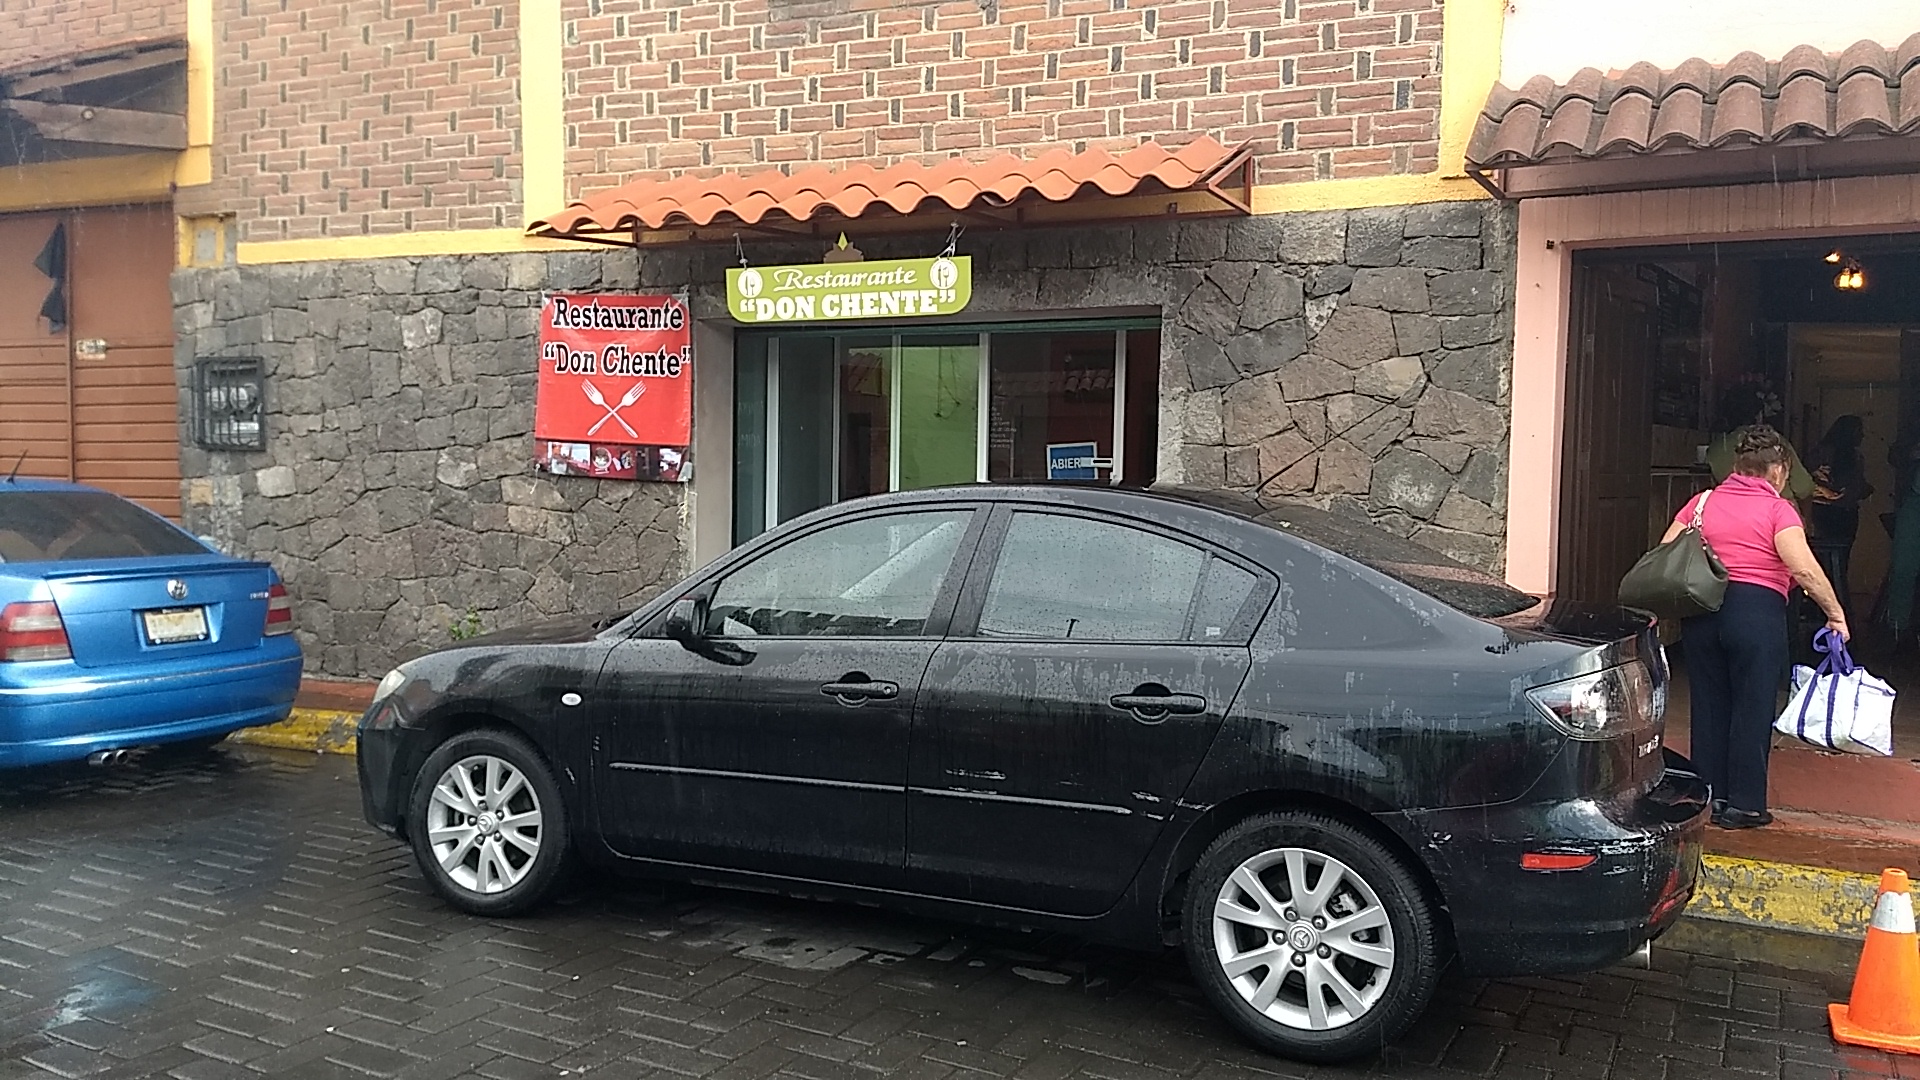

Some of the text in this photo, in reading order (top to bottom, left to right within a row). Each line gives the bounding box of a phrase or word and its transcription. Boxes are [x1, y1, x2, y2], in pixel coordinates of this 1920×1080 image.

[773, 266, 918, 292] Restaurante
[552, 297, 684, 330] Restaurante
[740, 289, 956, 321] “DON CHENTE”
[543, 342, 691, 378] “Don Chente”
[1051, 457, 1081, 470] ABIER
